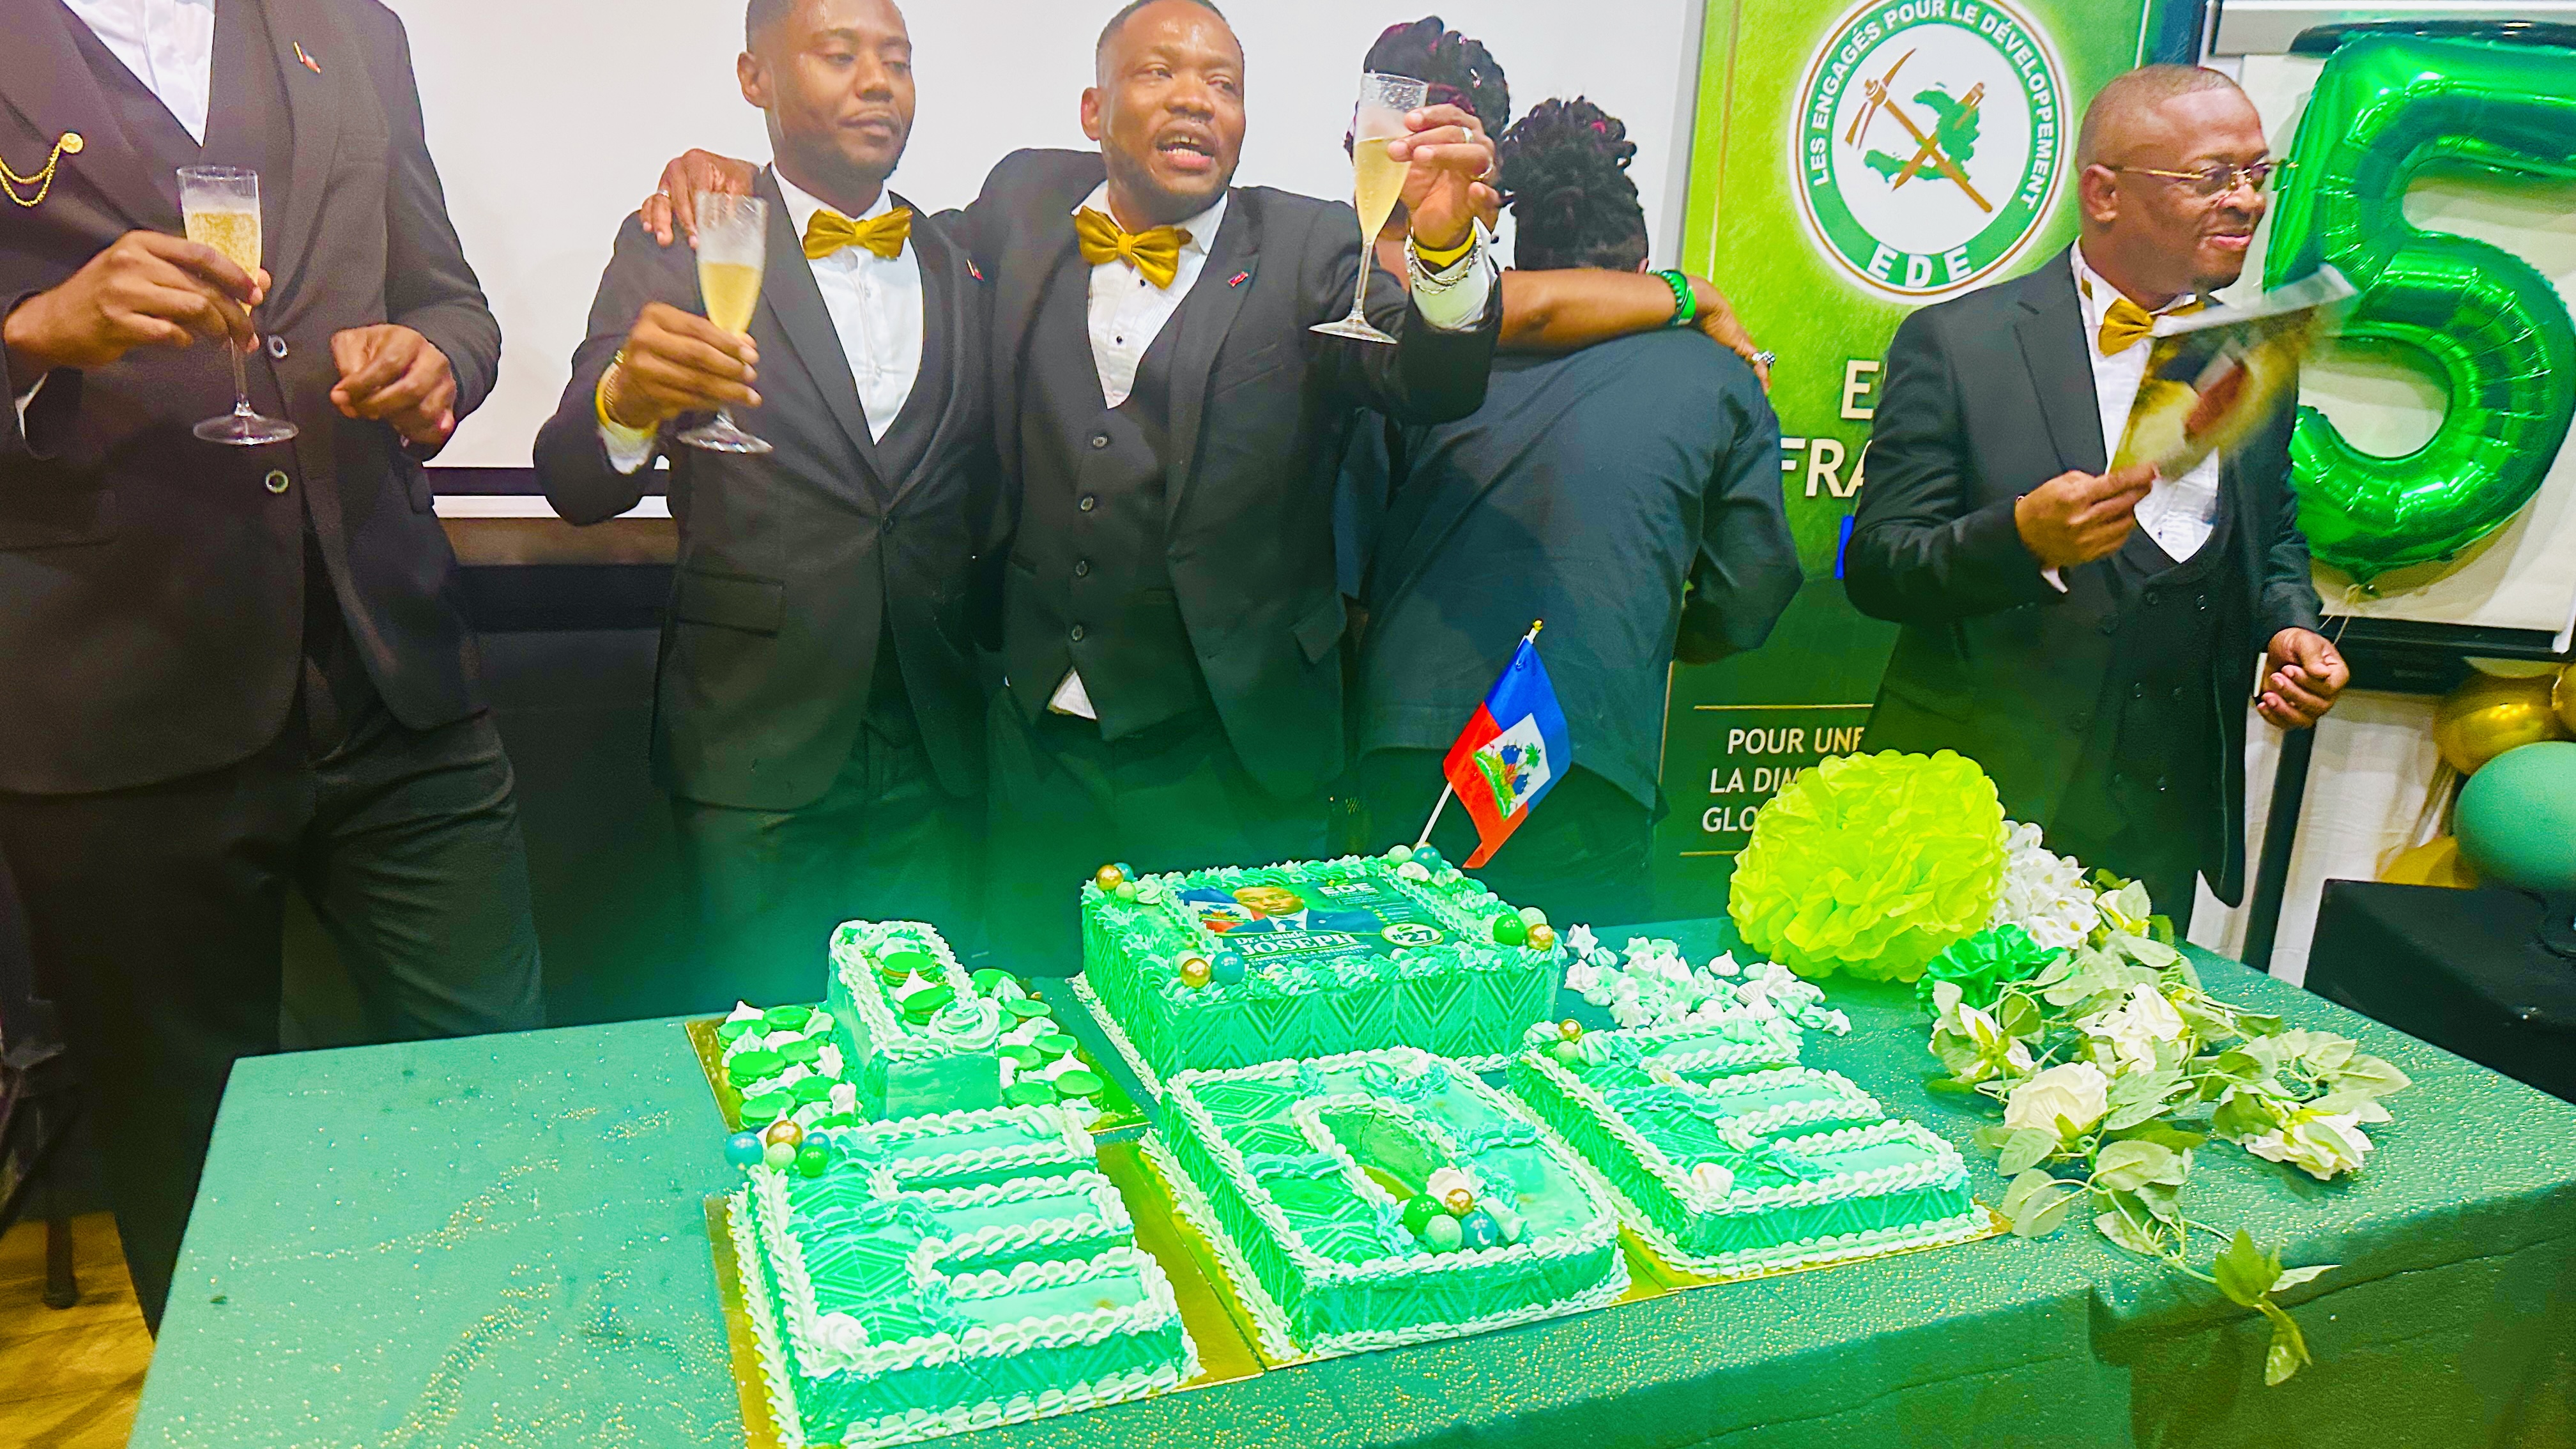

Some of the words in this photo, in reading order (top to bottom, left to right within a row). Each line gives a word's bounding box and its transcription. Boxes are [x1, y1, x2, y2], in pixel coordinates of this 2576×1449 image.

[1883, 0, 1946, 29] POUR
[1951, 1, 1979, 24] LE
[1812, 22, 1881, 129] ENGAGÉS
[1979, 12, 2054, 210] DÉVELOPPEMENT
[1810, 137, 1829, 186] LES
[1727, 728, 1805, 755] POUR
[1710, 767, 1745, 793] LA
[1317, 883, 1376, 894] EDE
[1240, 933, 1361, 956] JOSEPH
[1259, 930, 1308, 942] Claude
